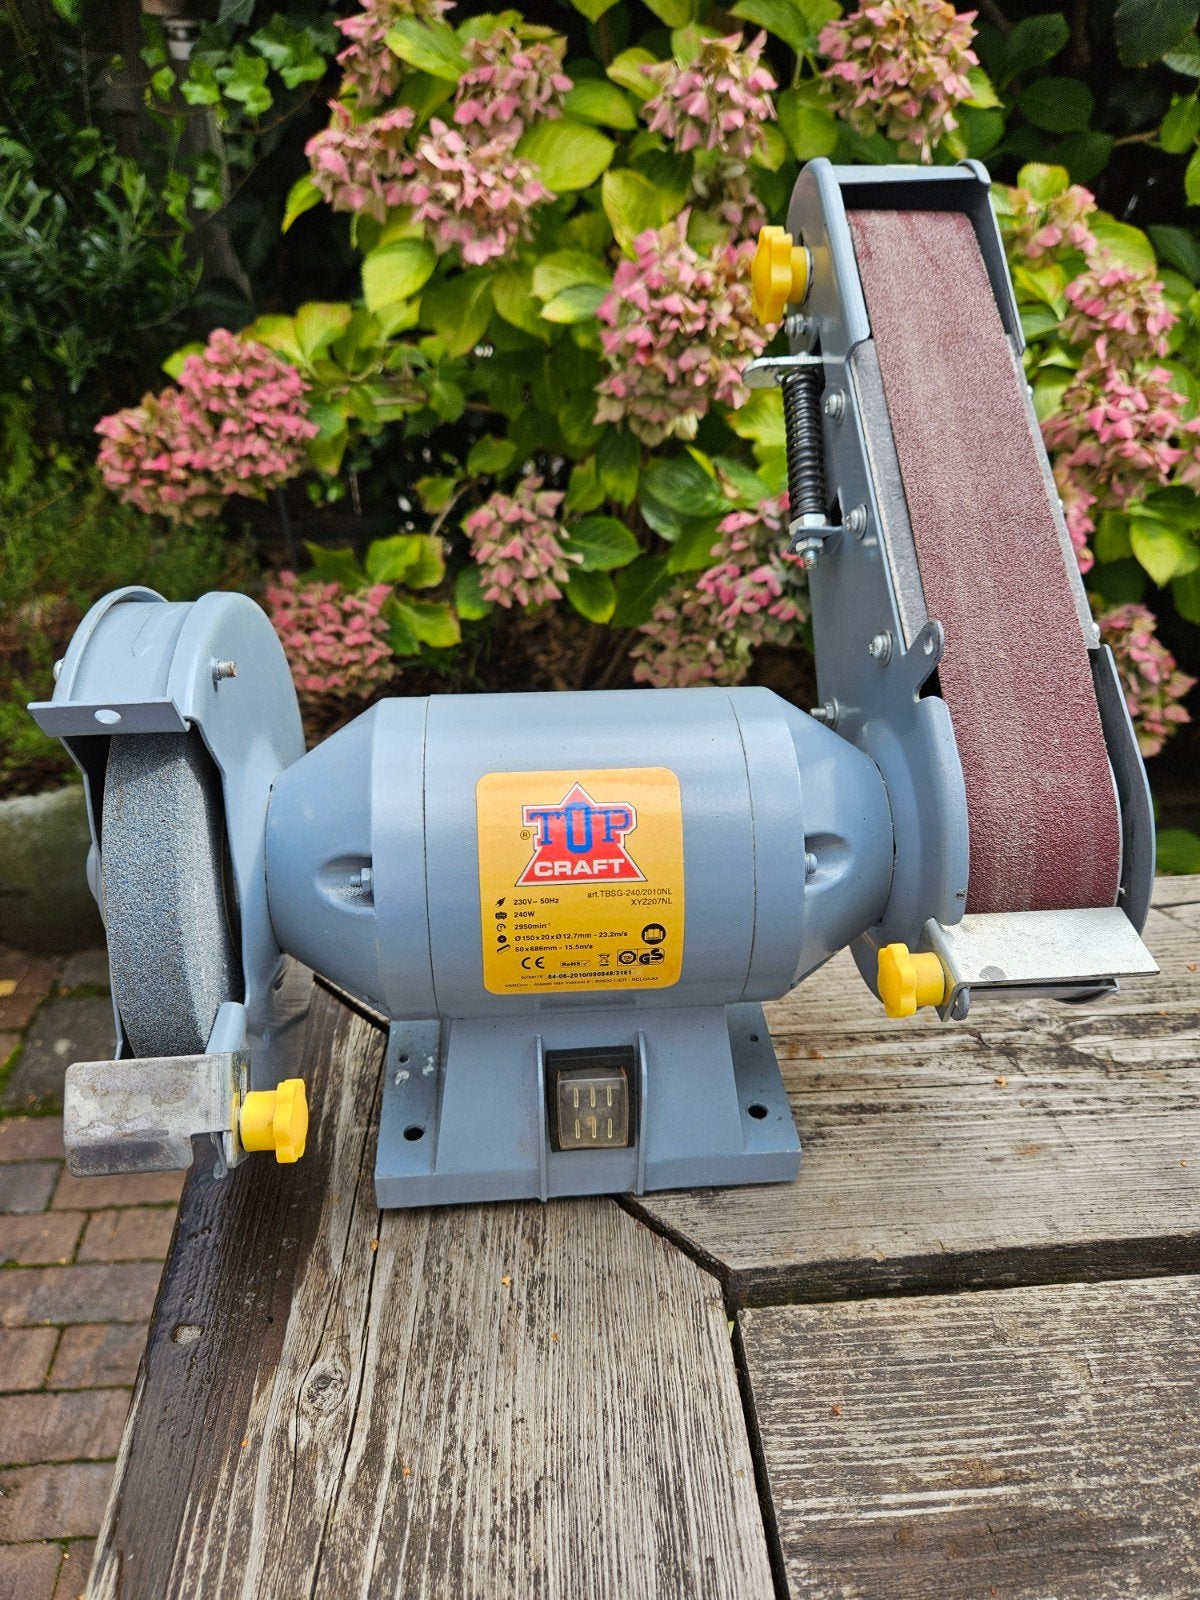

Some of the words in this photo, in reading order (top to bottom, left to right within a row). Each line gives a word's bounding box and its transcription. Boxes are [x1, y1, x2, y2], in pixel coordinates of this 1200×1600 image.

[529, 801, 630, 854] TOP
[533, 858, 625, 877] CRAFT
[630, 898, 673, 906] XYZ207NL
[598, 930, 628, 938] 23.2m/s
